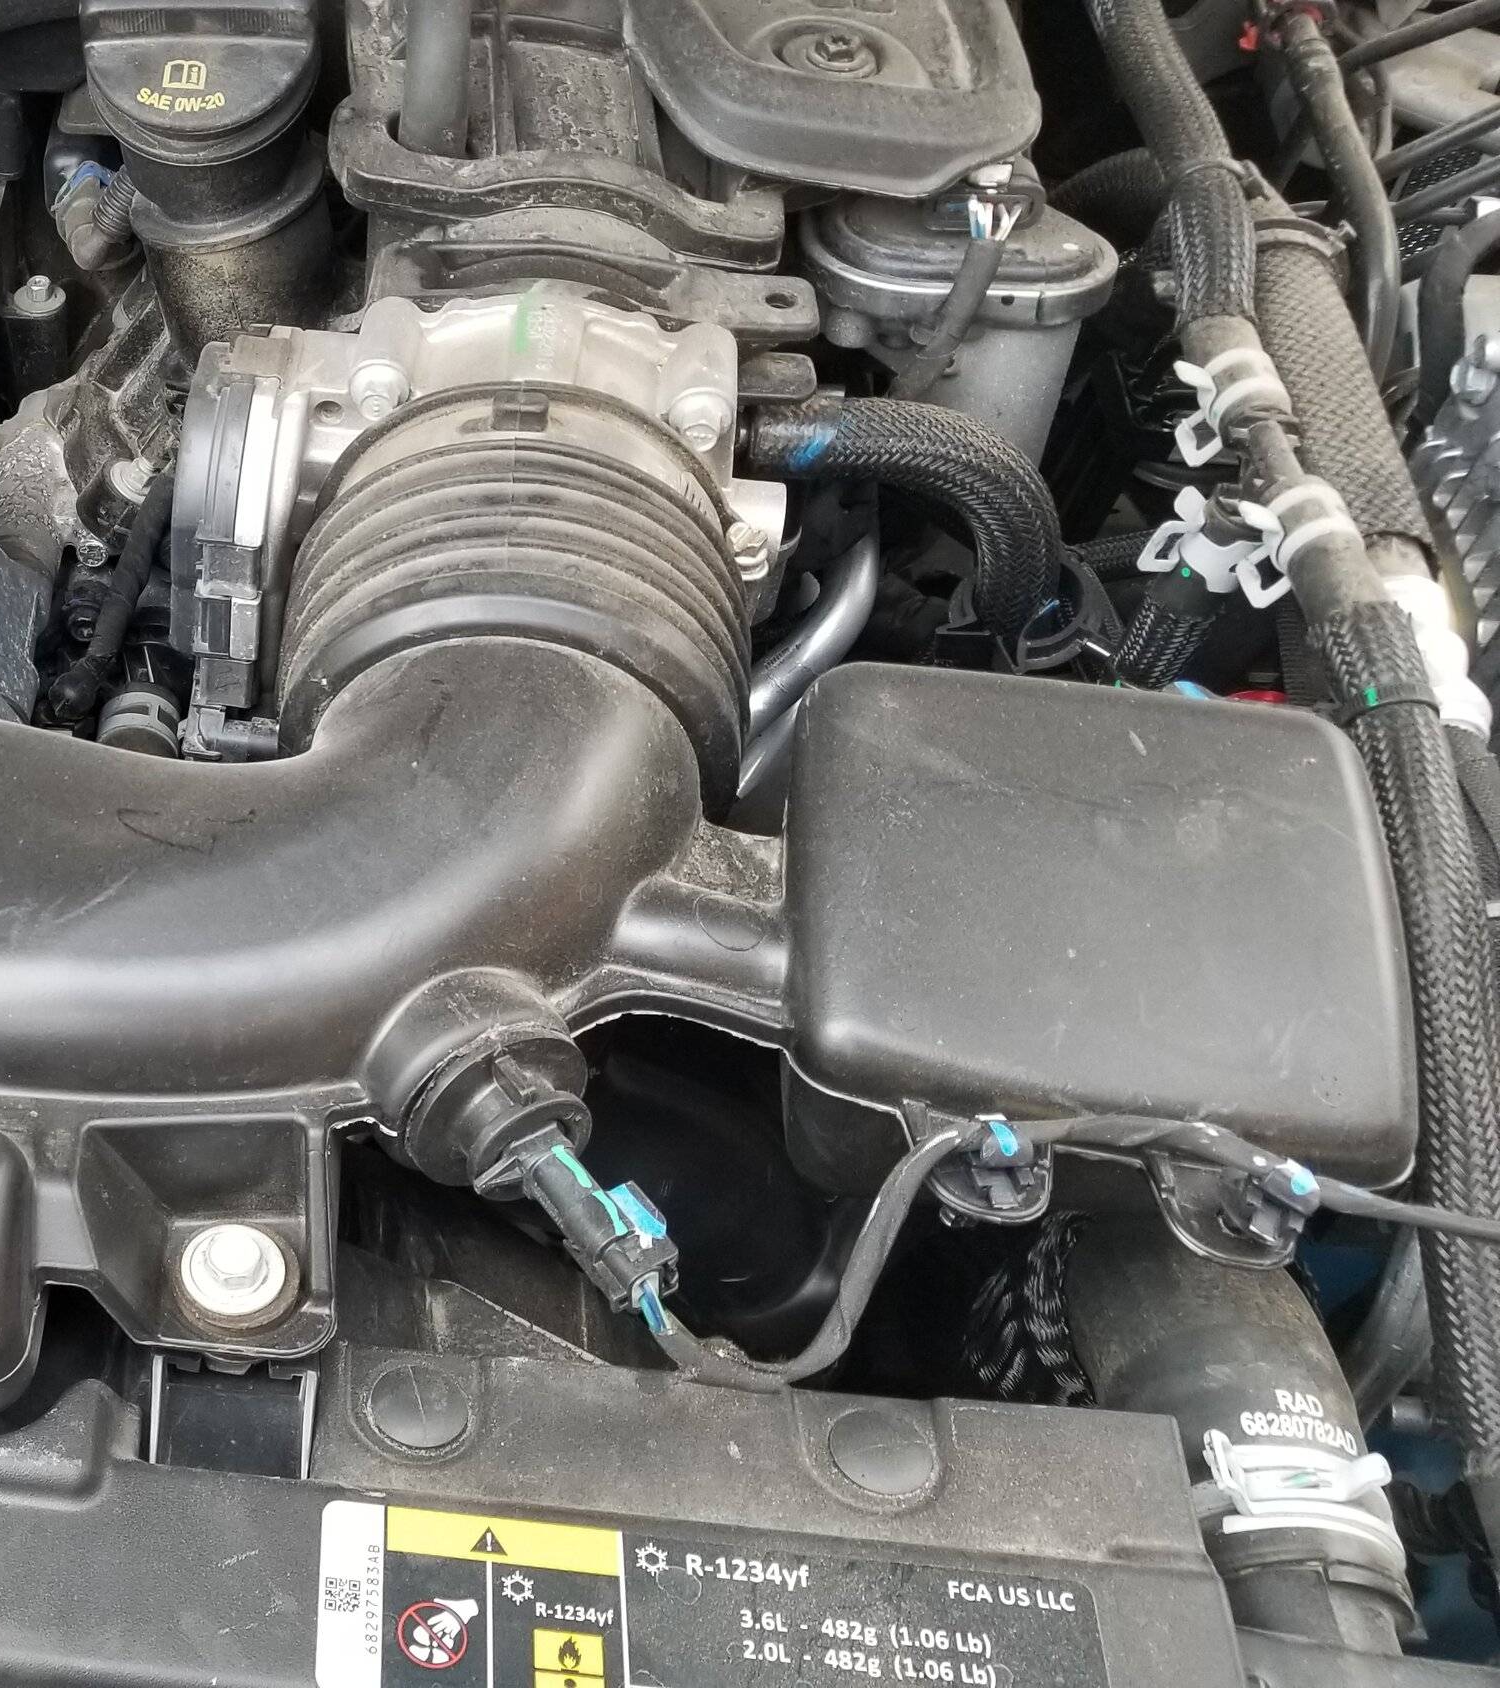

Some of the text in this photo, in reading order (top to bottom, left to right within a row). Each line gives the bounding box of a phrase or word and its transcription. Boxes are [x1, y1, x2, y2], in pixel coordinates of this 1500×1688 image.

[136, 87, 226, 112] SAE 0W-20
[1274, 1388, 1324, 1418] RAD
[1239, 1410, 1358, 1456] 68280782AD
[685, 1552, 810, 1592] R-1234yf
[364, 1543, 381, 1655] 68297583AB
[535, 1601, 614, 1628] R-1234yf
[947, 1579, 1077, 1612] FCA US LLC
[739, 1608, 789, 1633] 3.6L
[820, 1617, 878, 1647] 482g
[888, 1622, 950, 1650] (1.06
[955, 1631, 992, 1659] Lb)
[742, 1638, 792, 1664] 2.0L
[823, 1648, 882, 1678] 482g
[893, 1651, 955, 1682] (1.06
[959, 1662, 997, 1688] Lb)
